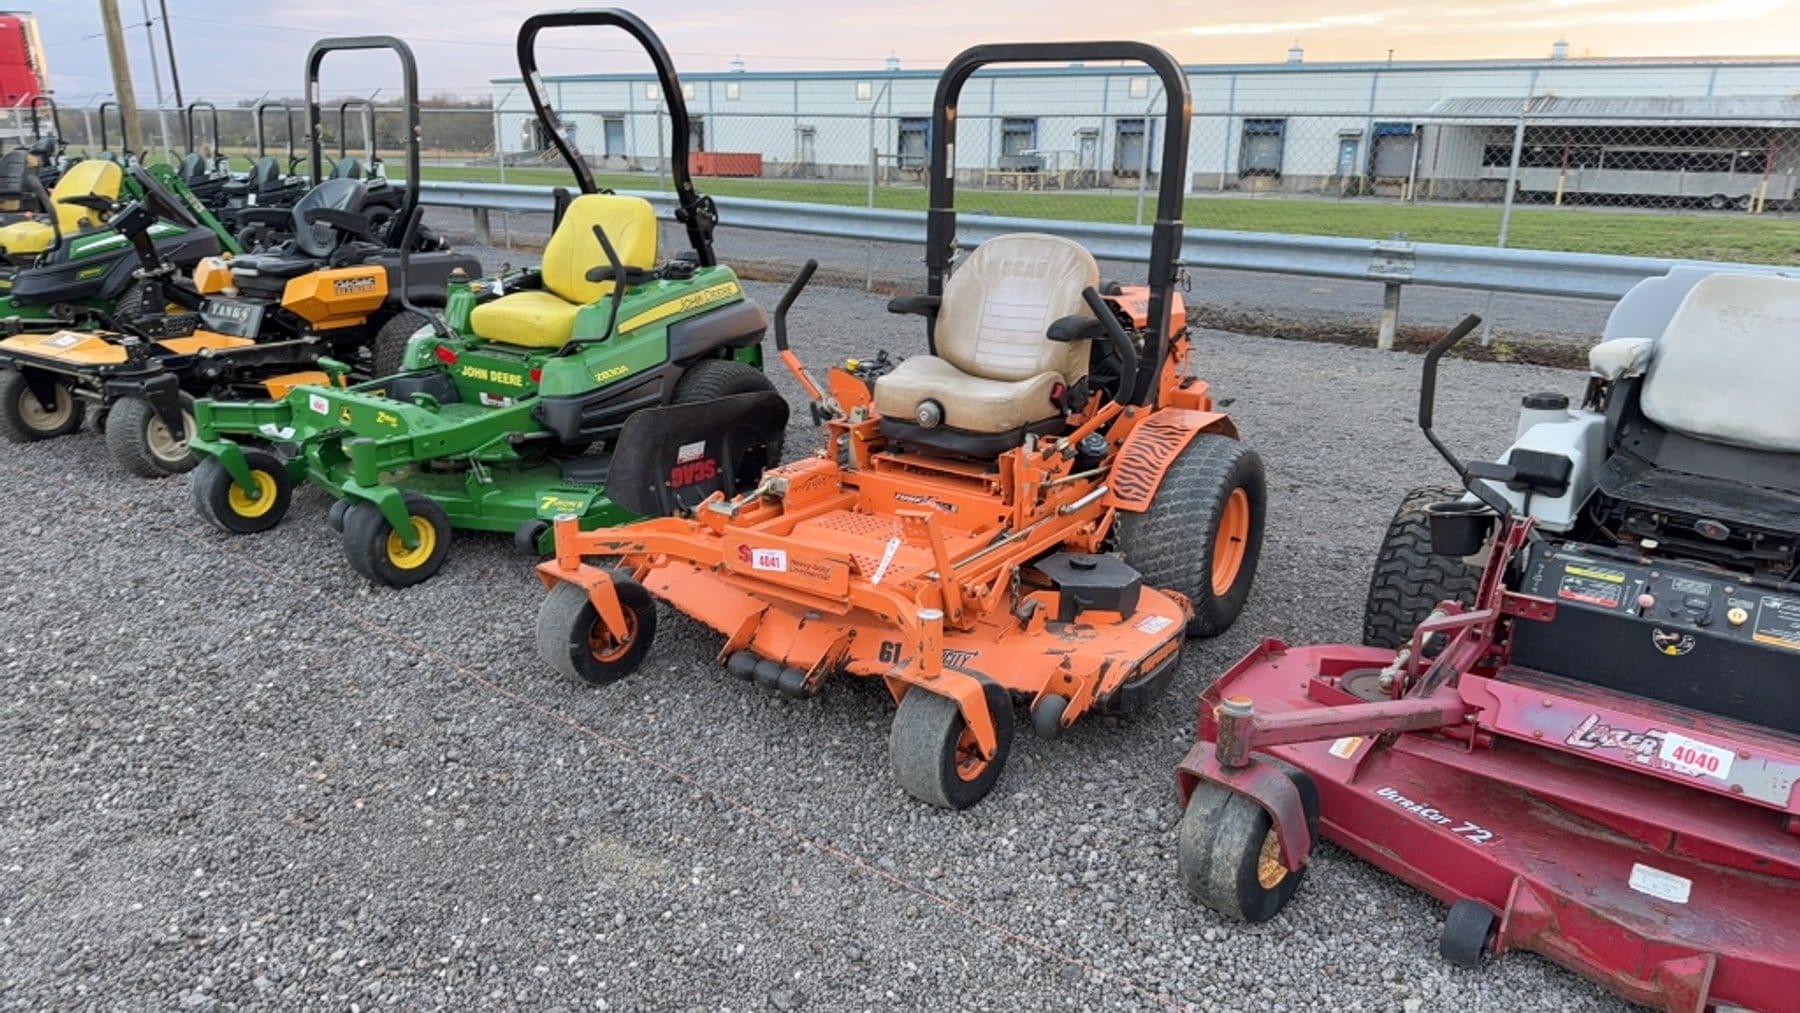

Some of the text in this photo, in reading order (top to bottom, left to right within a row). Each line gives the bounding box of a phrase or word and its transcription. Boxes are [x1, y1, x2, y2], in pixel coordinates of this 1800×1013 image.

[680, 285, 732, 311] JOHN DEERE
[461, 365, 523, 387] JOHN DEERE
[671, 459, 716, 489] SCAG
[760, 555, 780, 569] 4041
[879, 641, 902, 664] 61
[1672, 745, 1720, 773] 4040
[1451, 821, 1493, 844] 72
